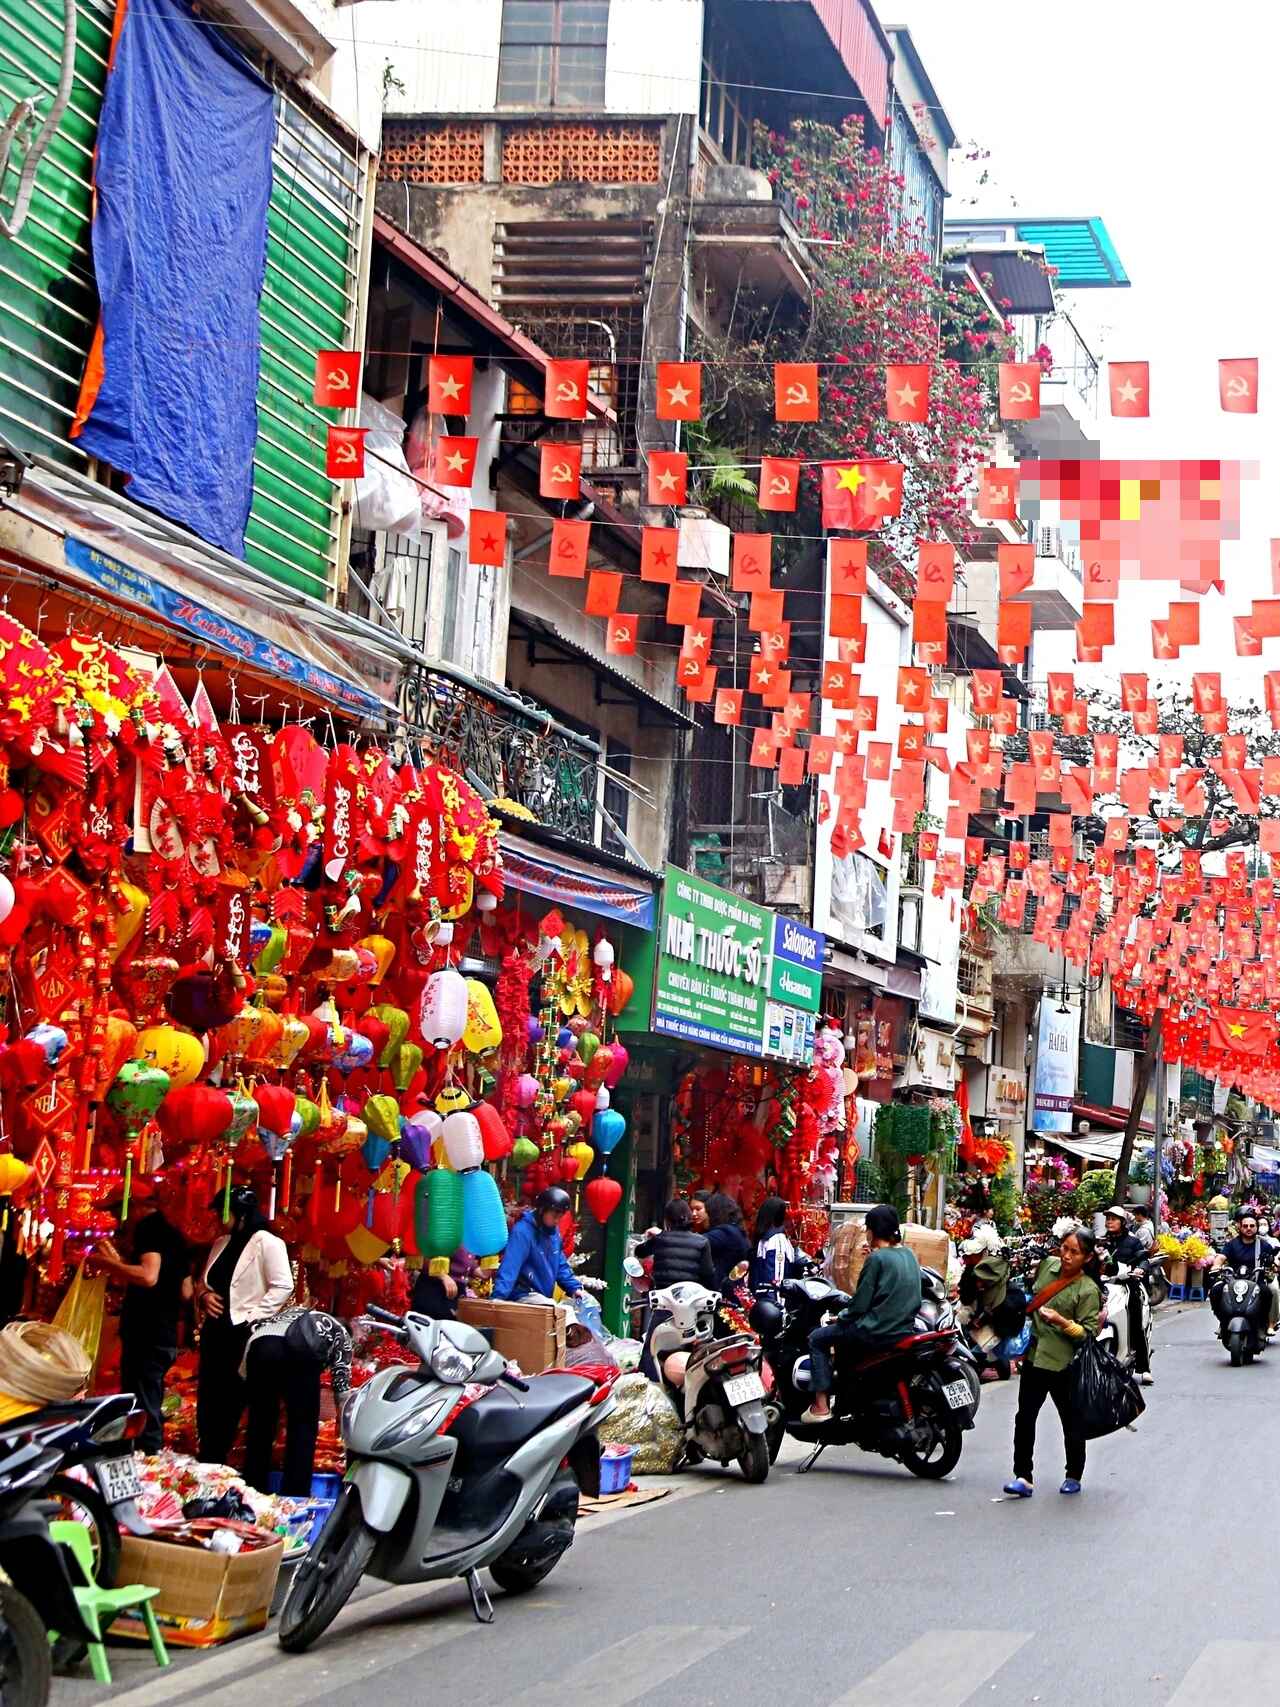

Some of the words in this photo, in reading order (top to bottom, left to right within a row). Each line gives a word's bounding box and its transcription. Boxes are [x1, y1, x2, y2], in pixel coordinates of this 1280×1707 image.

[666, 912, 694, 962] NHÀ
[696, 925, 742, 978] THUỐC
[744, 937, 763, 985] SỐ
[783, 923, 816, 961] Salonpas
